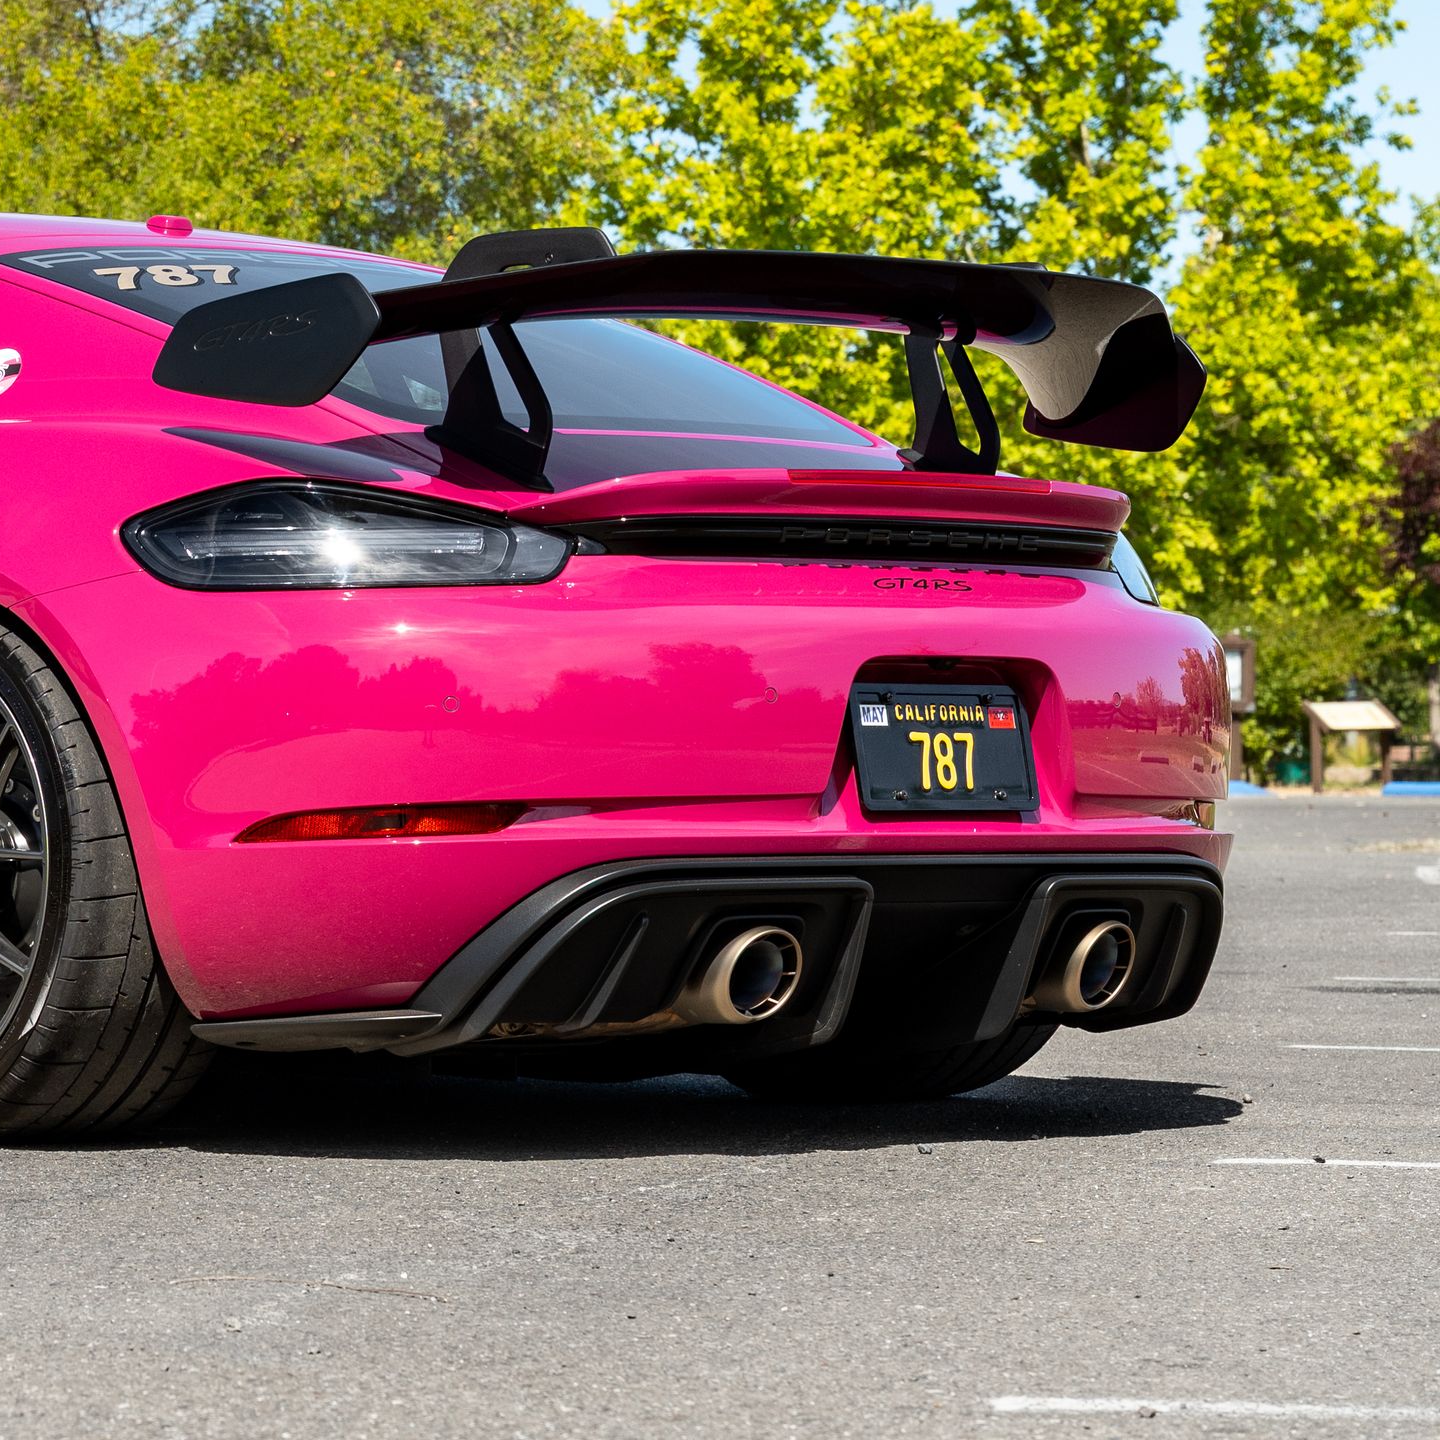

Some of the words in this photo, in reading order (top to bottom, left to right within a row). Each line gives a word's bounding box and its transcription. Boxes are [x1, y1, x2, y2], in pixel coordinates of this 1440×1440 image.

[93, 264, 240, 290] 787
[780, 526, 1040, 552] PORSCHE
[861, 706, 885, 723] MAY
[894, 704, 985, 722] CALIFORNIA
[909, 731, 974, 791] 787
